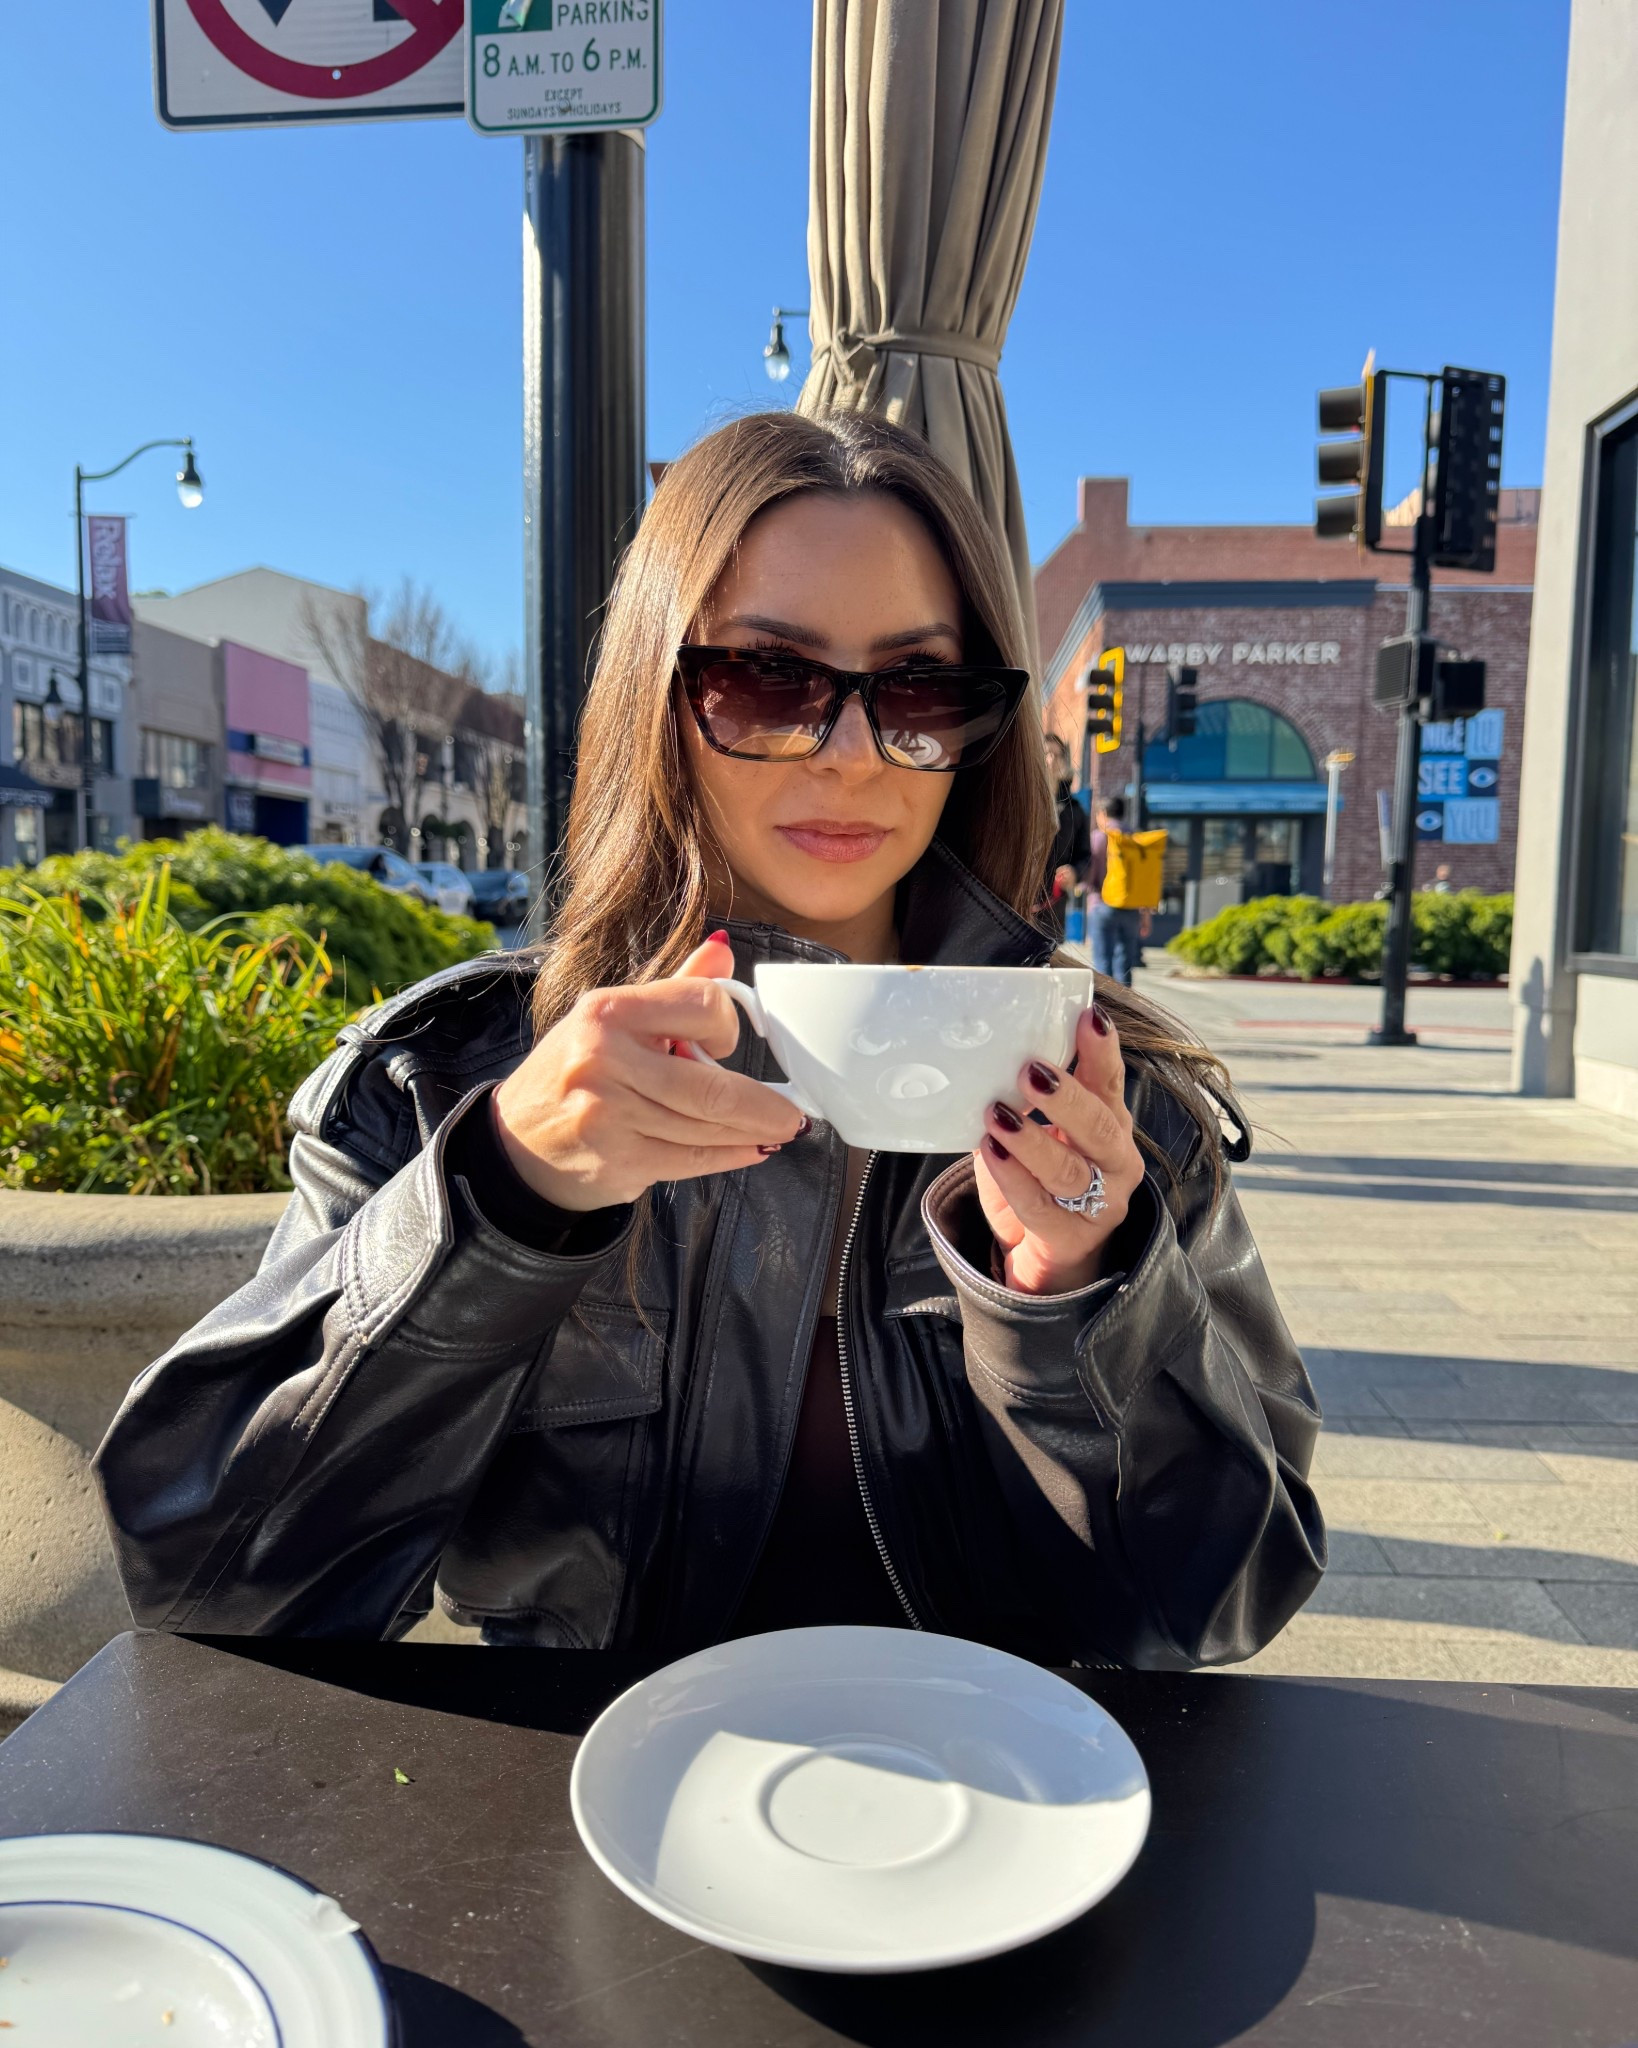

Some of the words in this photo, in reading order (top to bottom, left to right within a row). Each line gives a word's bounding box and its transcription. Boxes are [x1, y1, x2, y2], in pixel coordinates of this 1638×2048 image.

[557, 0, 649, 27] PARKING
[483, 43, 500, 78] 8
[507, 53, 546, 77] A.M.
[550, 52, 574, 74] TO
[583, 37, 600, 72] 6
[609, 47, 648, 71] P.M.
[544, 88, 583, 102] EXCEPT
[1124, 642, 1224, 666] WARBY
[1232, 641, 1341, 666] PARKER
[1421, 716, 1465, 753] NICE
[1418, 760, 1465, 795] SEE
